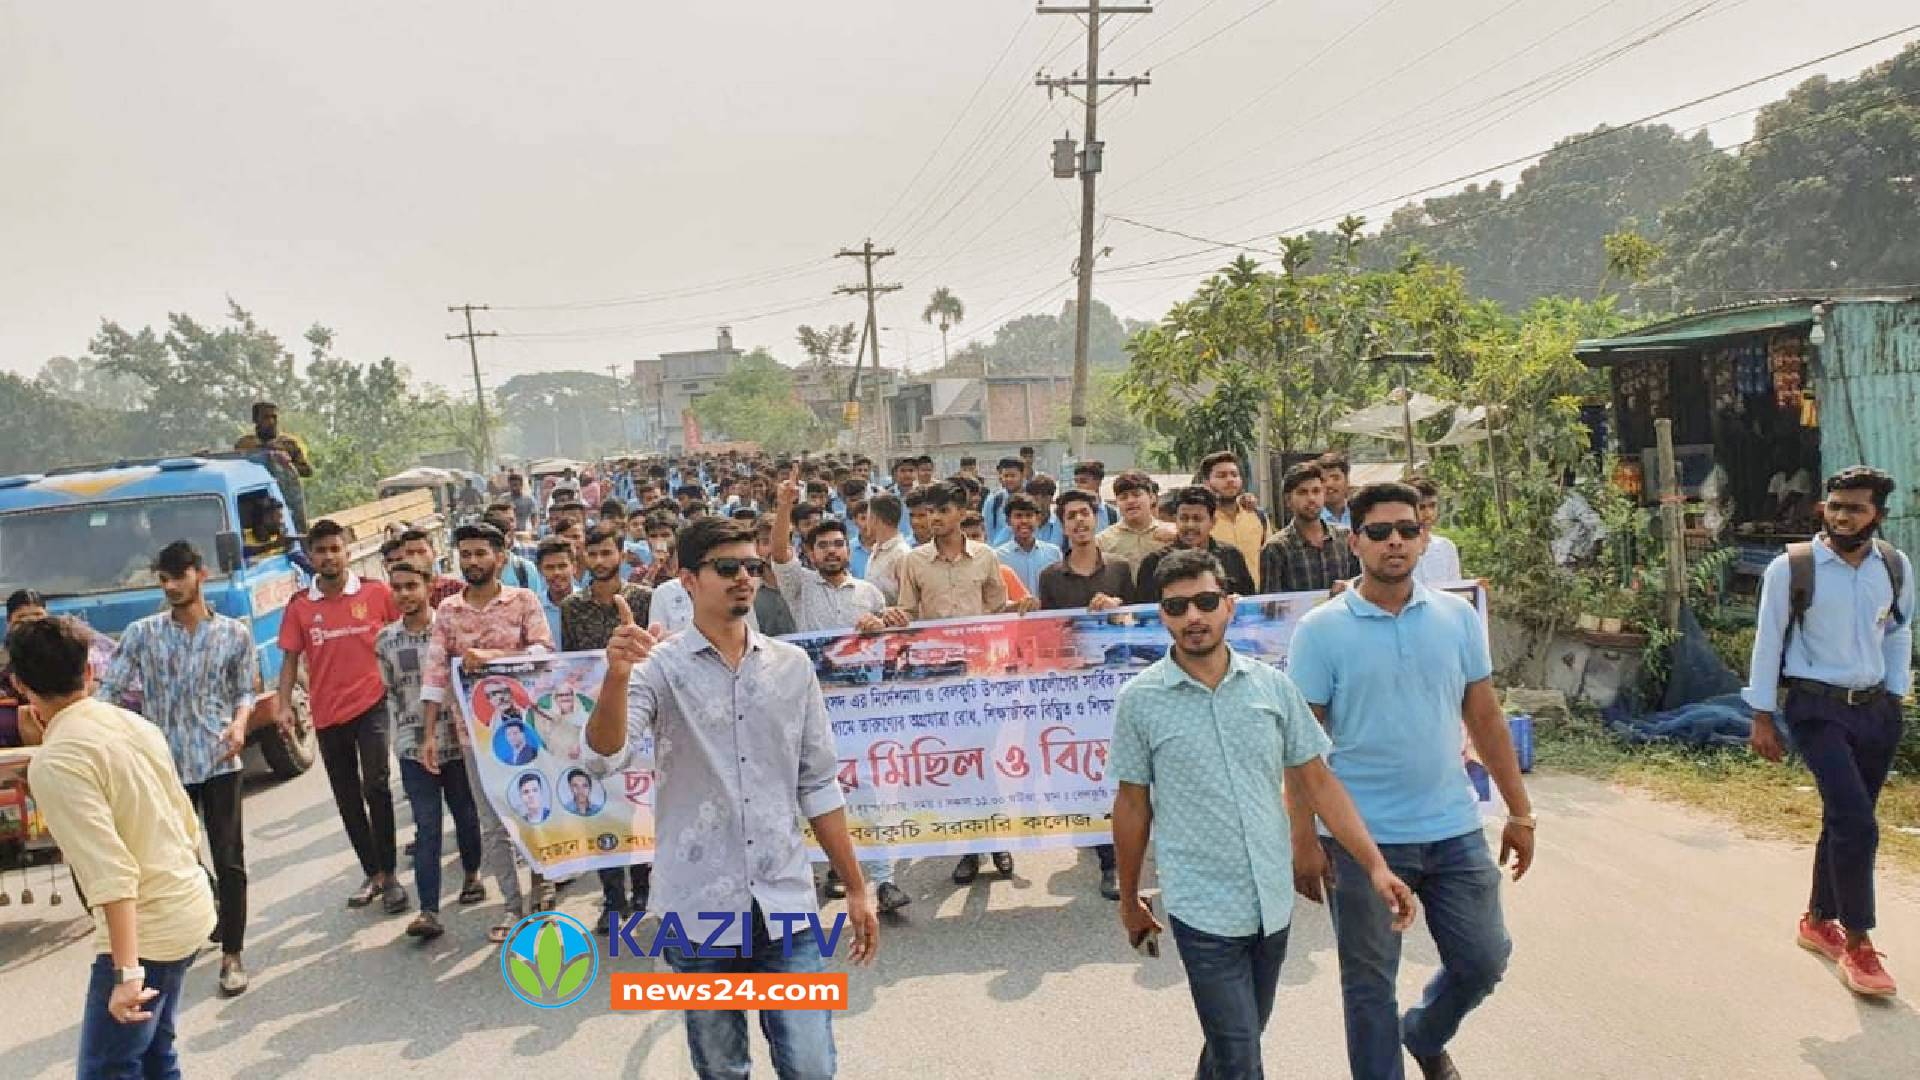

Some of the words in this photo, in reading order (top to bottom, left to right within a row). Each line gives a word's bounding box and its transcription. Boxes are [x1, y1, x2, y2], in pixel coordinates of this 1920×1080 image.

[836, 758, 859, 793] র
[866, 735, 985, 788] মিছিল
[996, 745, 1030, 779] ও
[930, 813, 1011, 836] সরকারি
[1022, 813, 1092, 831] কলেজ
